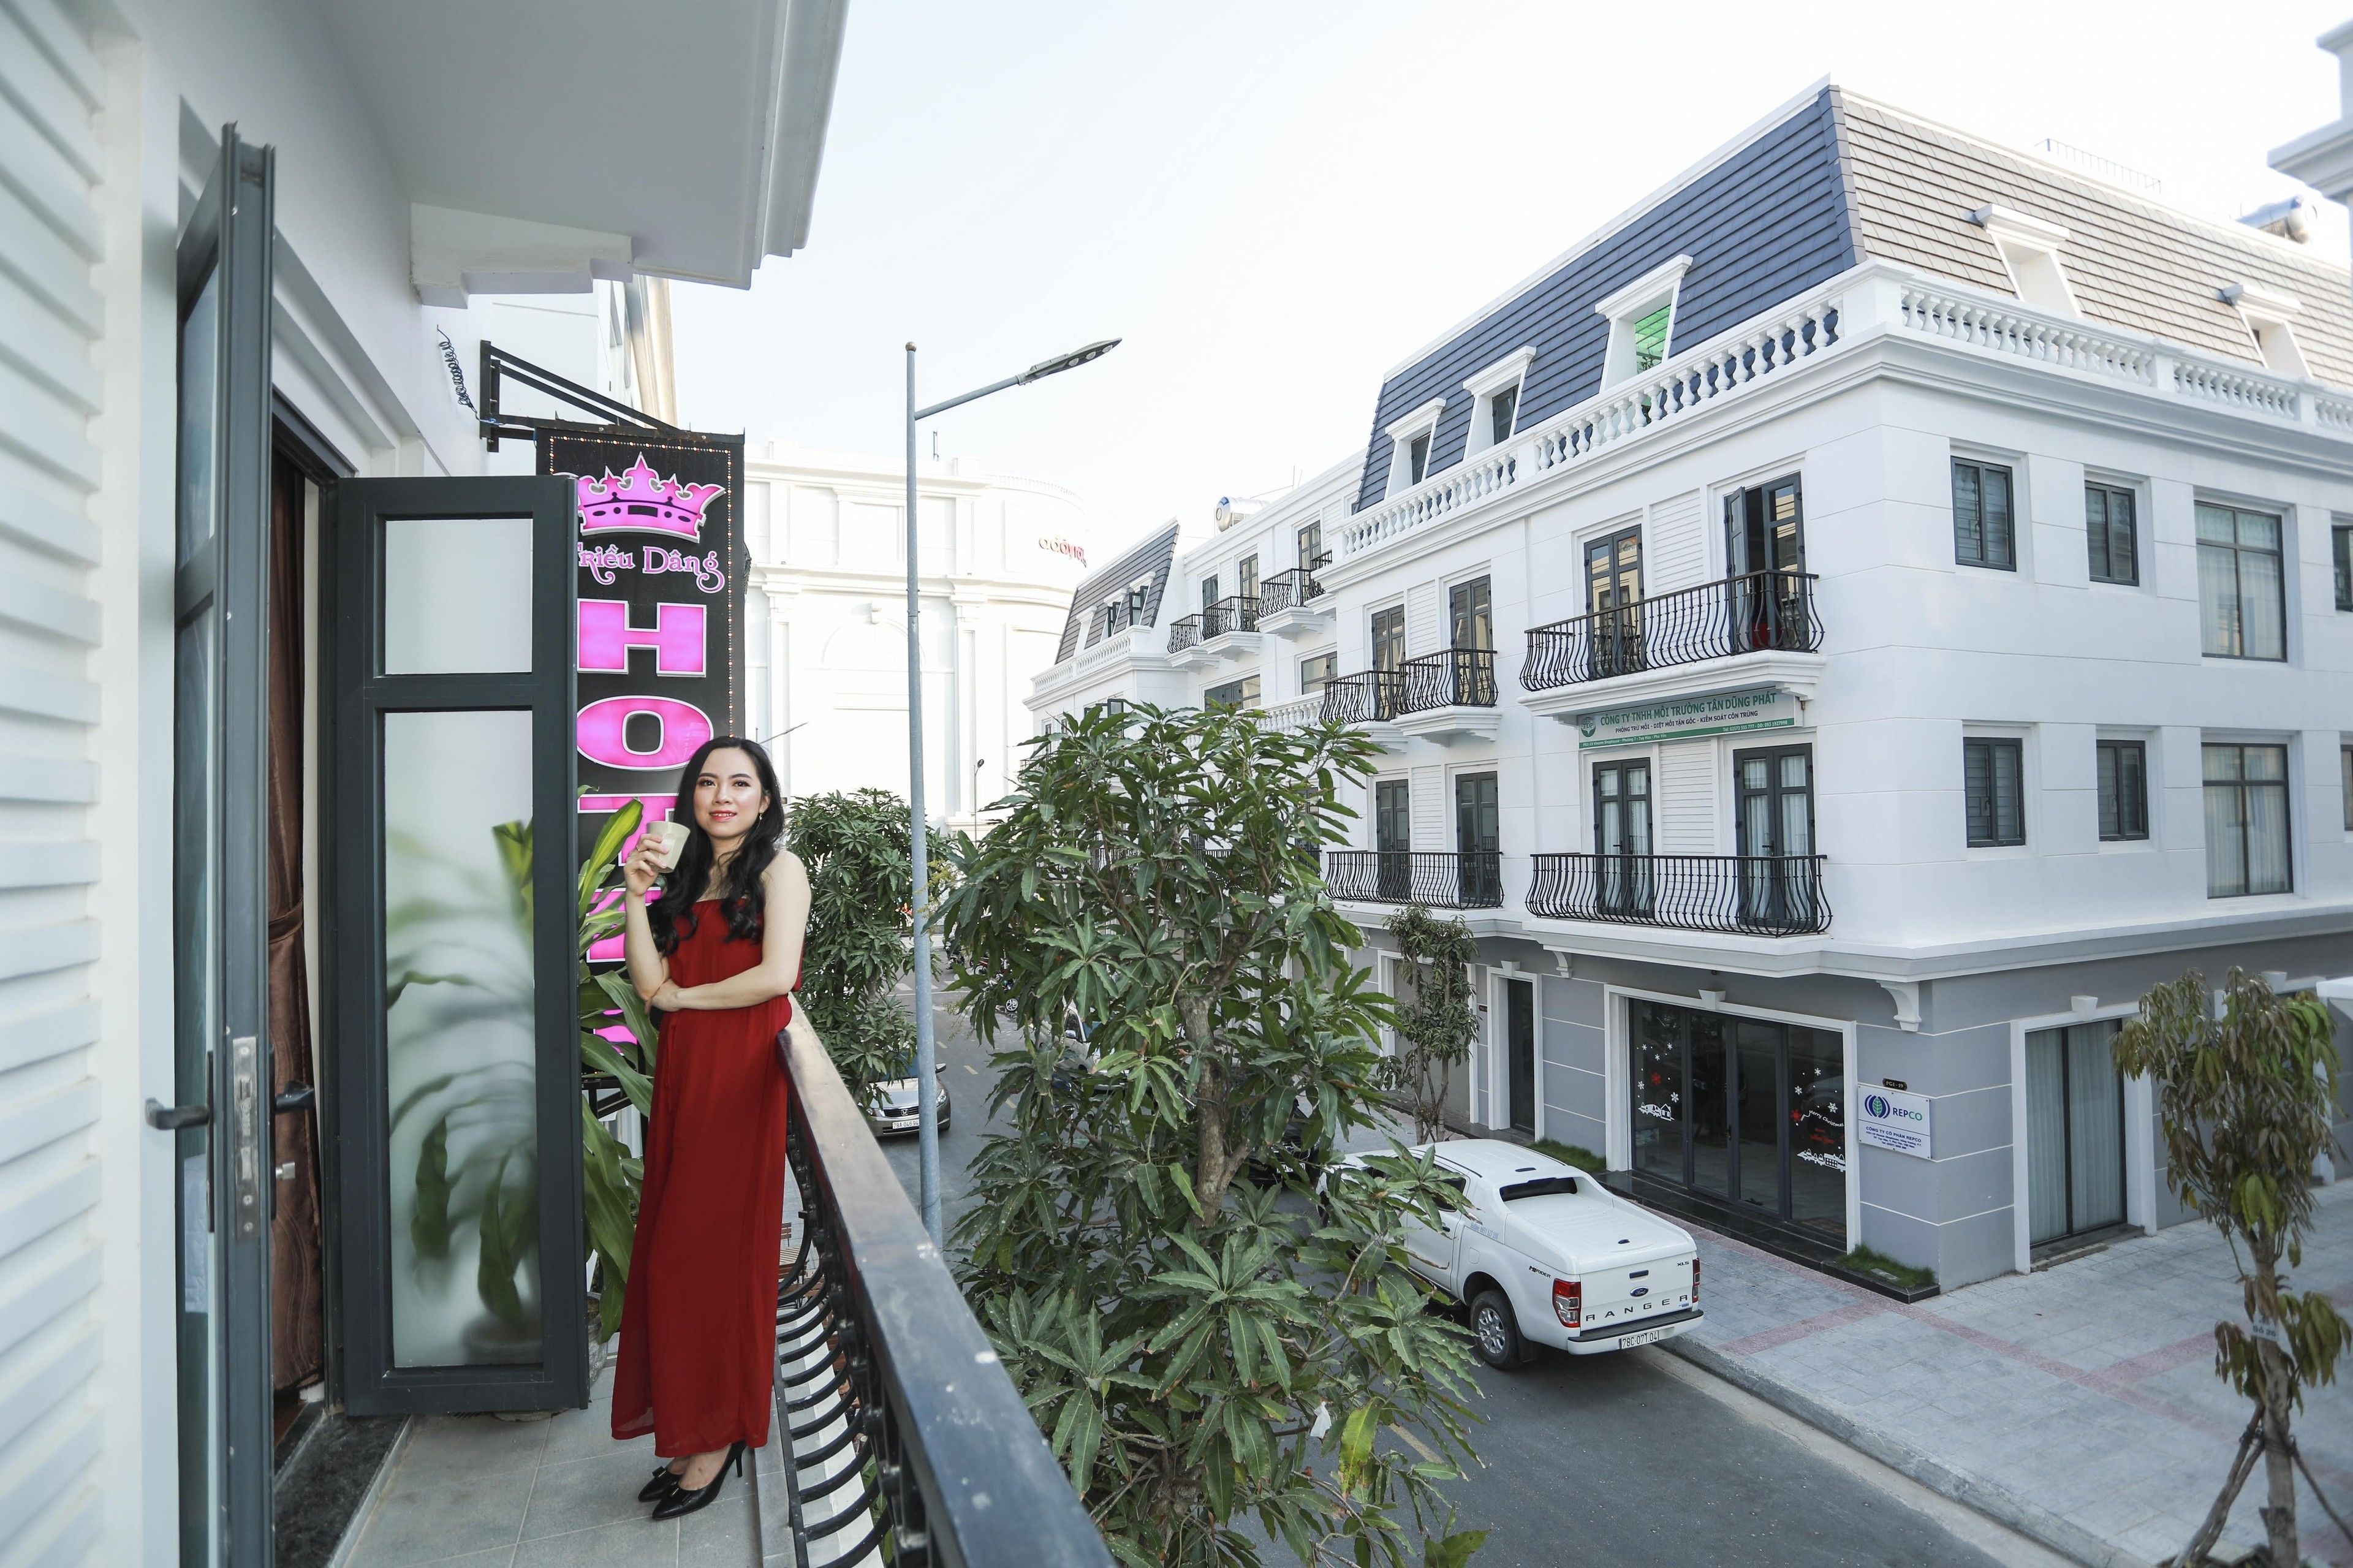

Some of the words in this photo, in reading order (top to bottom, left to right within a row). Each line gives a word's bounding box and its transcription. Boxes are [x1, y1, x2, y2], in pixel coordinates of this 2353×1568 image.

[642, 546, 725, 594] Dâng
[1601, 714, 1620, 726] CÔNG
[1621, 713, 1630, 723] TY
[1632, 710, 1652, 722] TNHH
[1654, 706, 1669, 718] MÔI
[1671, 702, 1705, 716] TRƯỜNG
[1707, 699, 1724, 711] TÂN
[1726, 696, 1750, 710] DŨNG
[1752, 691, 1776, 706] PHÁT
[1700, 714, 1713, 723] KIỂM
[1809, 1110, 1822, 1119] Merry
[1822, 1116, 1844, 1127] Christmas
[1892, 1107, 1923, 1121] REPCO
[1586, 1295, 1688, 1322] RANGER
